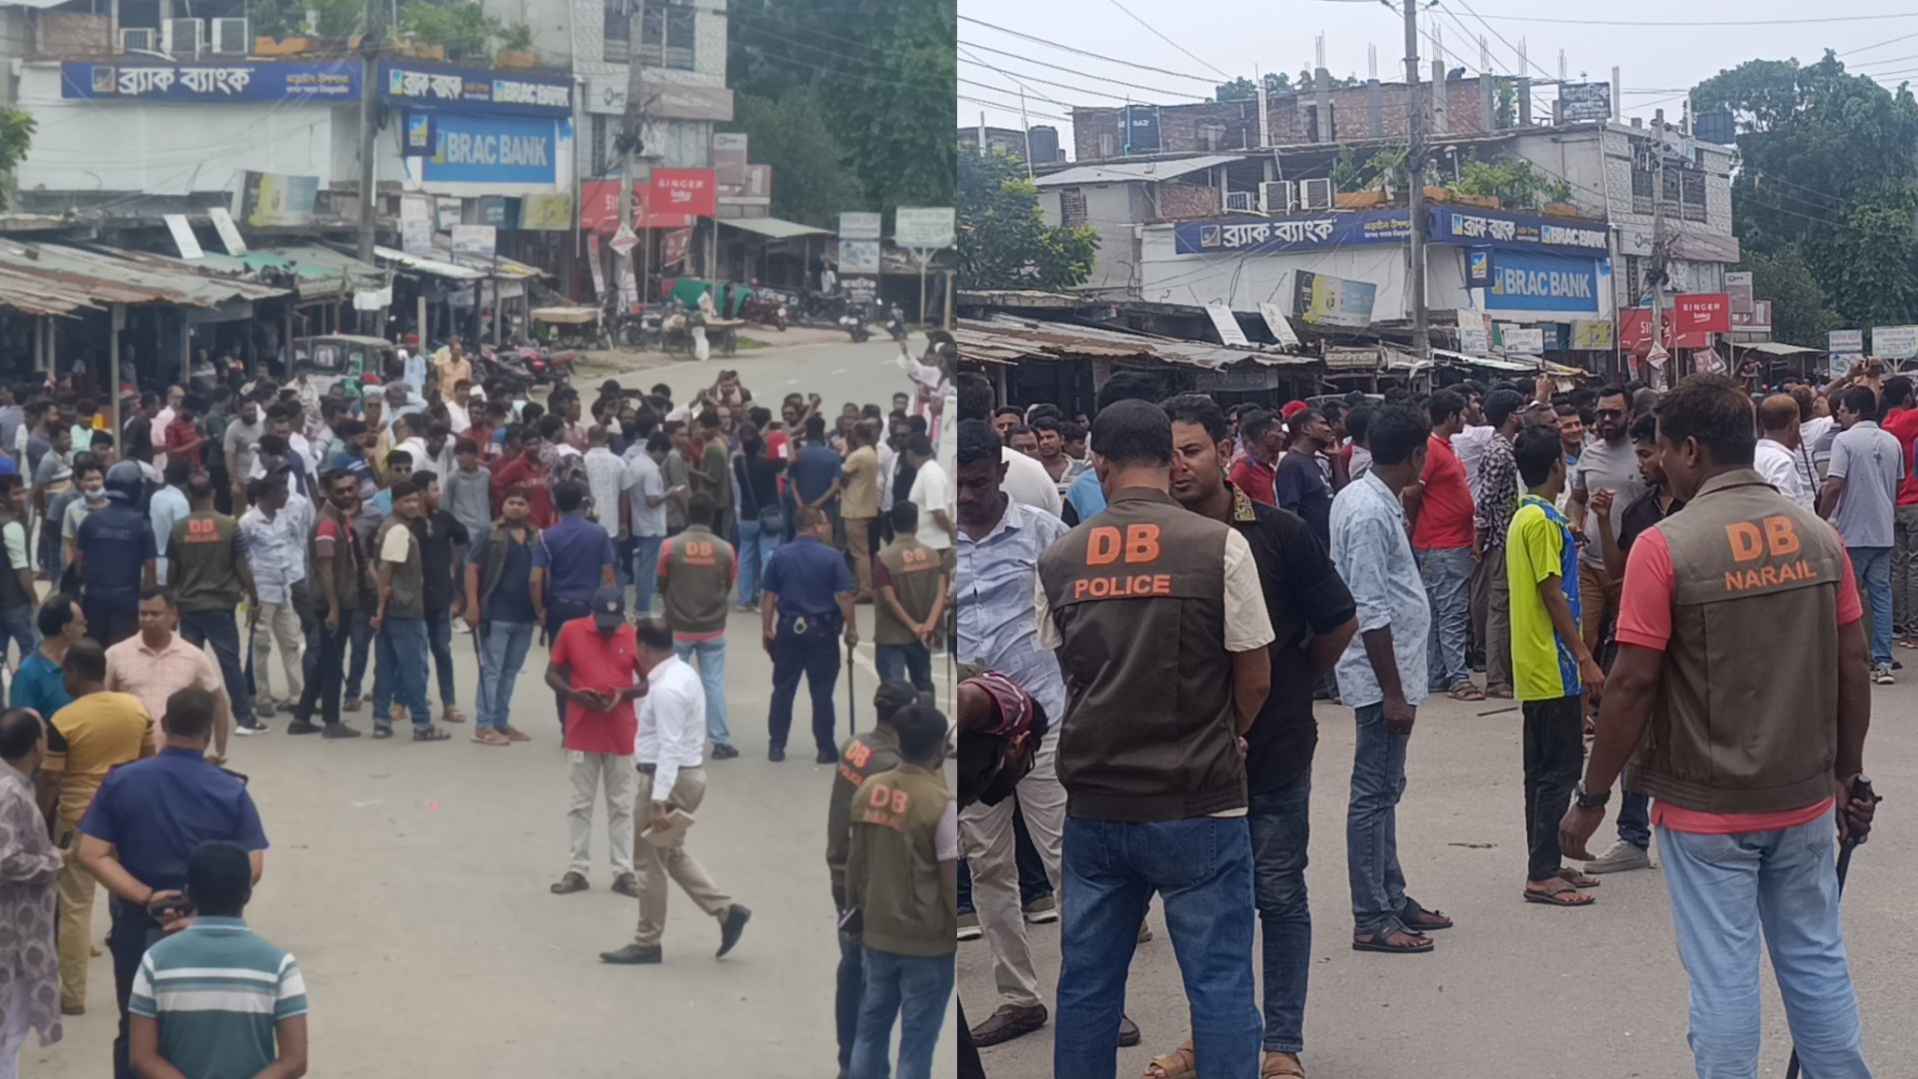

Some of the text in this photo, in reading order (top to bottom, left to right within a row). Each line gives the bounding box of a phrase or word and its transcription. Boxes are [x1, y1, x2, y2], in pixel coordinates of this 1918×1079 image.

[179, 67, 250, 95] ব্যাংক
[447, 132, 548, 166] BRAC BANK
[658, 178, 704, 189] SINGER
[1273, 219, 1333, 243] ব্যাংক
[1551, 226, 1578, 246] BRAC
[1504, 268, 1592, 298] BRAC BANK
[1683, 303, 1721, 312] SINGER
[1086, 523, 1161, 567] DB
[1726, 515, 1800, 563] DB
[1074, 574, 1172, 600] POLICE
[1724, 559, 1817, 592] NARAIL
[869, 783, 909, 815] DB
